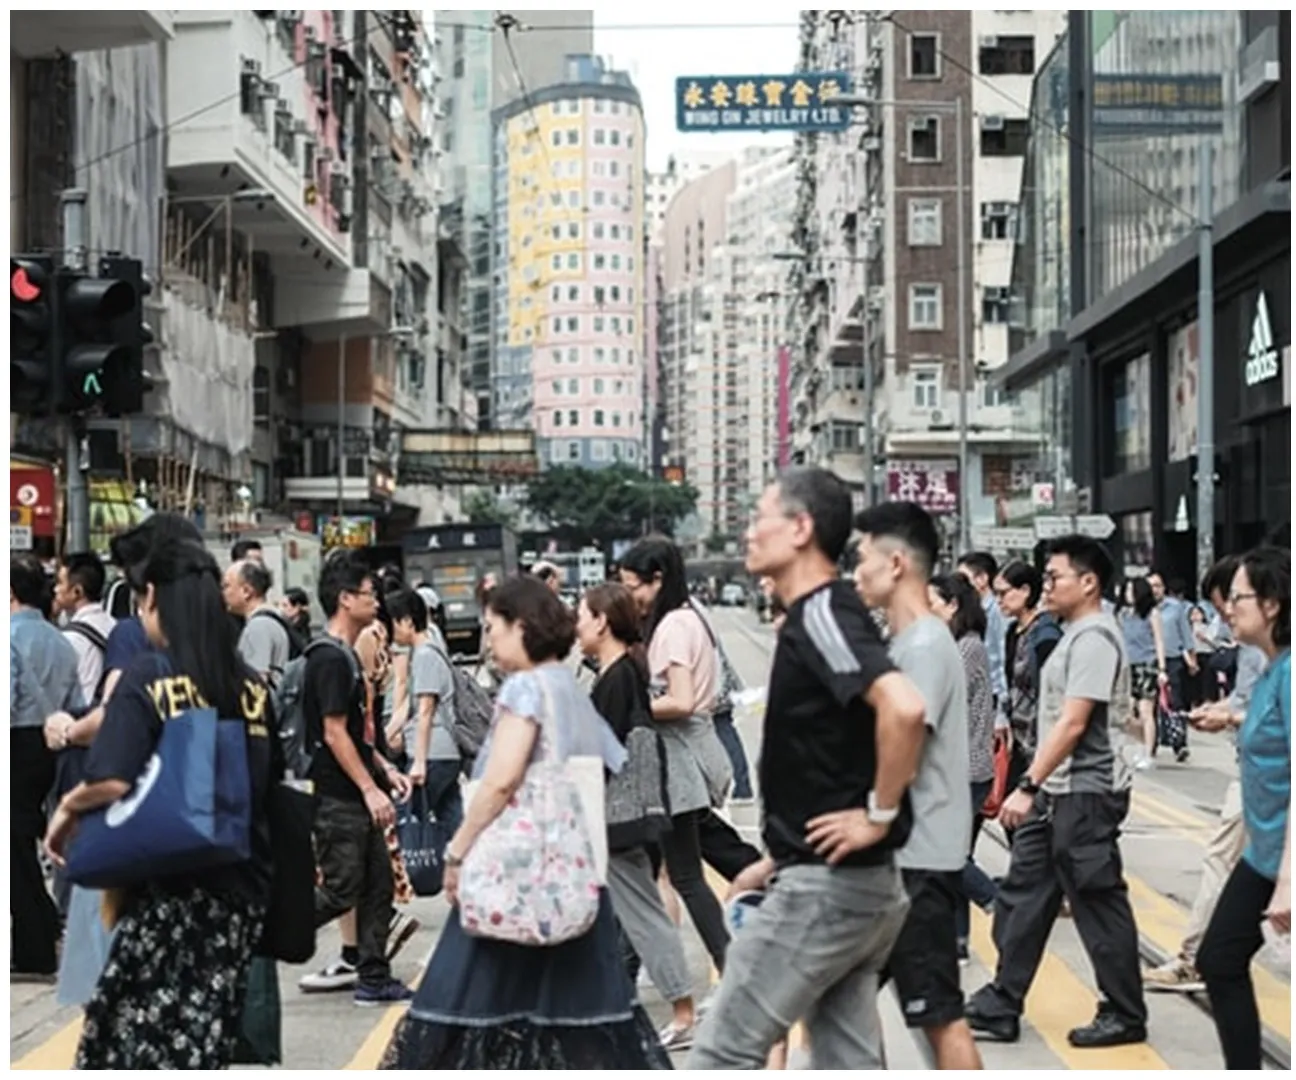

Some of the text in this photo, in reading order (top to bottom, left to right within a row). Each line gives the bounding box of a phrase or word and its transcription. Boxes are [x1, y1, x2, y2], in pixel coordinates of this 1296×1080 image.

[684, 109, 719, 126] WING
[721, 109, 742, 125] ON
[744, 107, 810, 125] JEWELRY
